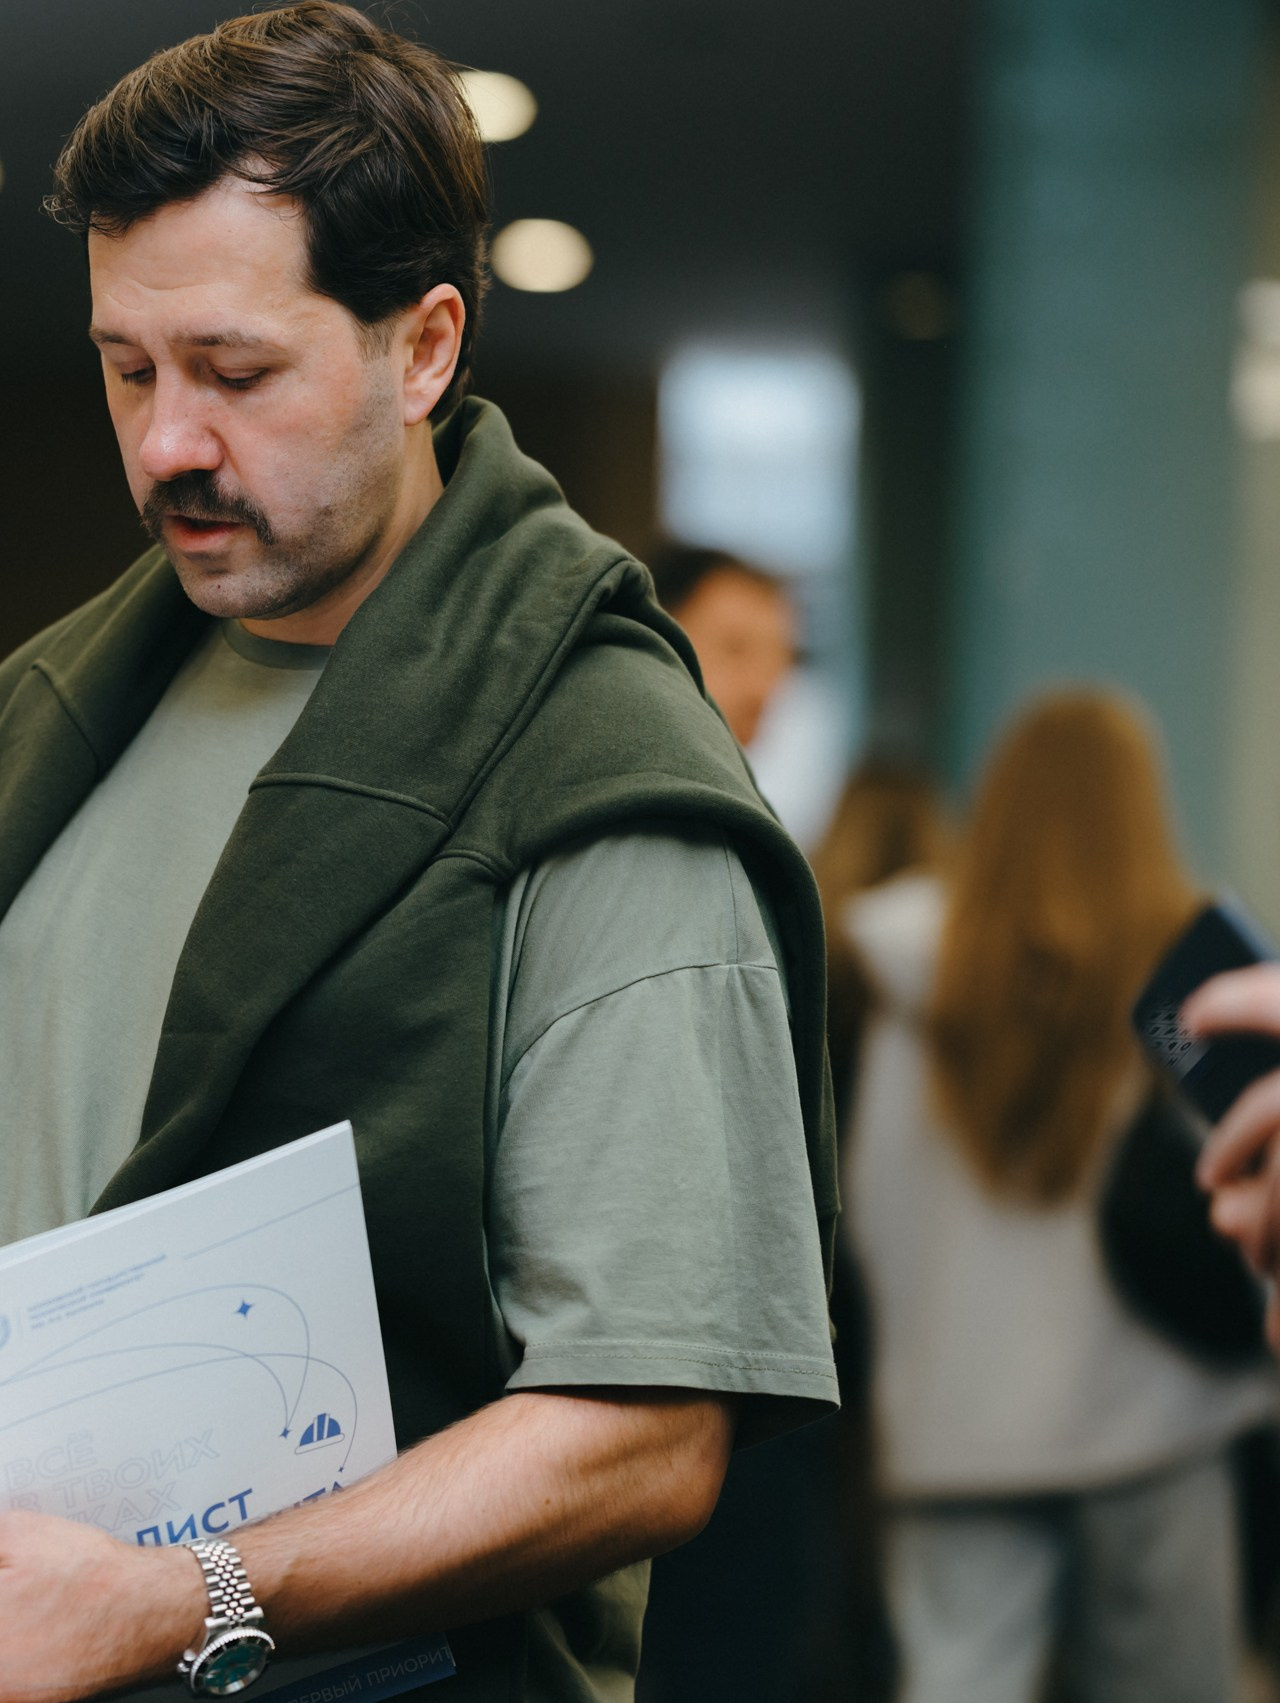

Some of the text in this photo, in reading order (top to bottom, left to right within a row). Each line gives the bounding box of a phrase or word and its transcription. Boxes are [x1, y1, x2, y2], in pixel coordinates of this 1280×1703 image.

[4, 1428, 98, 1493] ВСЁ
[53, 1428, 221, 1509] ТВОИХ
[288, 1673, 362, 1703] ЕРВЫЙ
